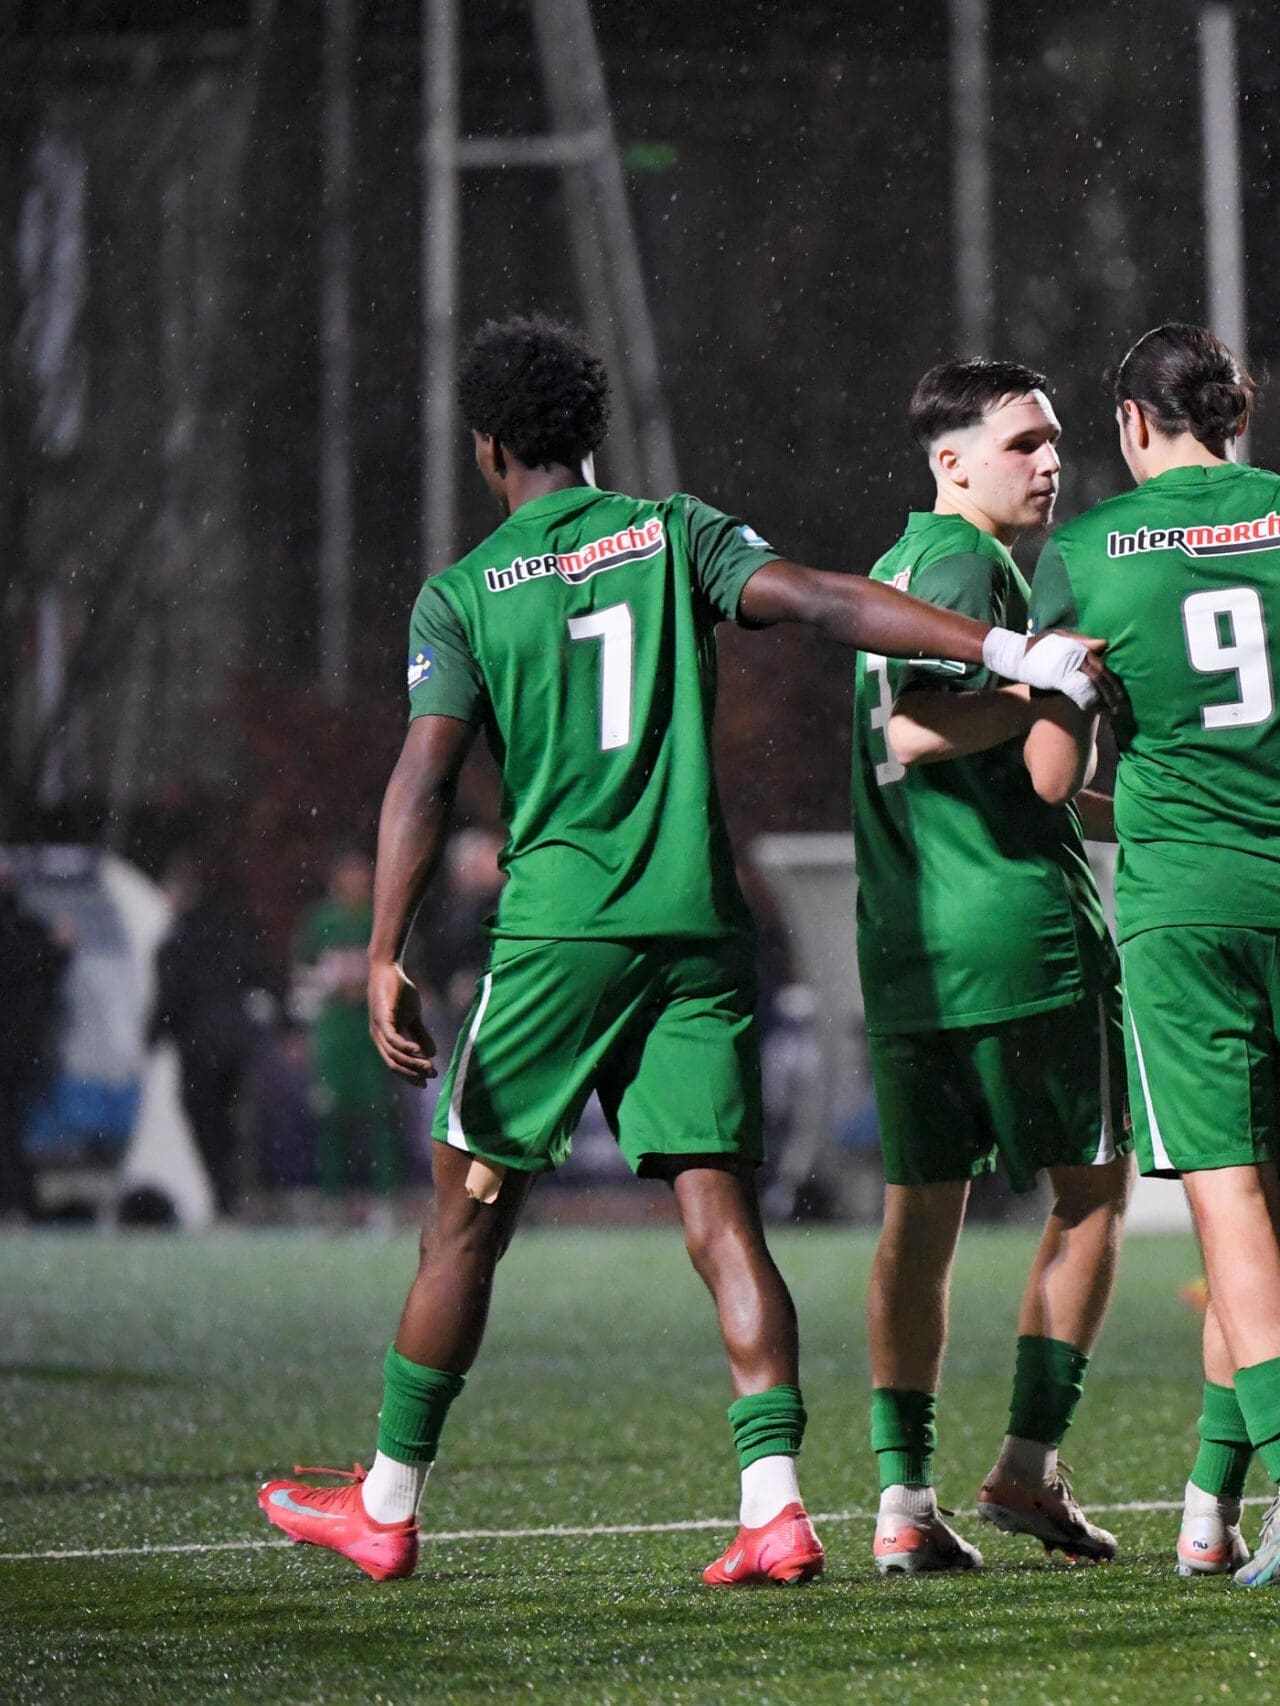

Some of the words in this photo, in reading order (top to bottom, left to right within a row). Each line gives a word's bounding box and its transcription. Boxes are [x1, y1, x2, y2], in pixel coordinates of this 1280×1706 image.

[486, 521, 662, 590] Intermarché
[567, 603, 634, 751] 7
[1183, 586, 1275, 729] 9
